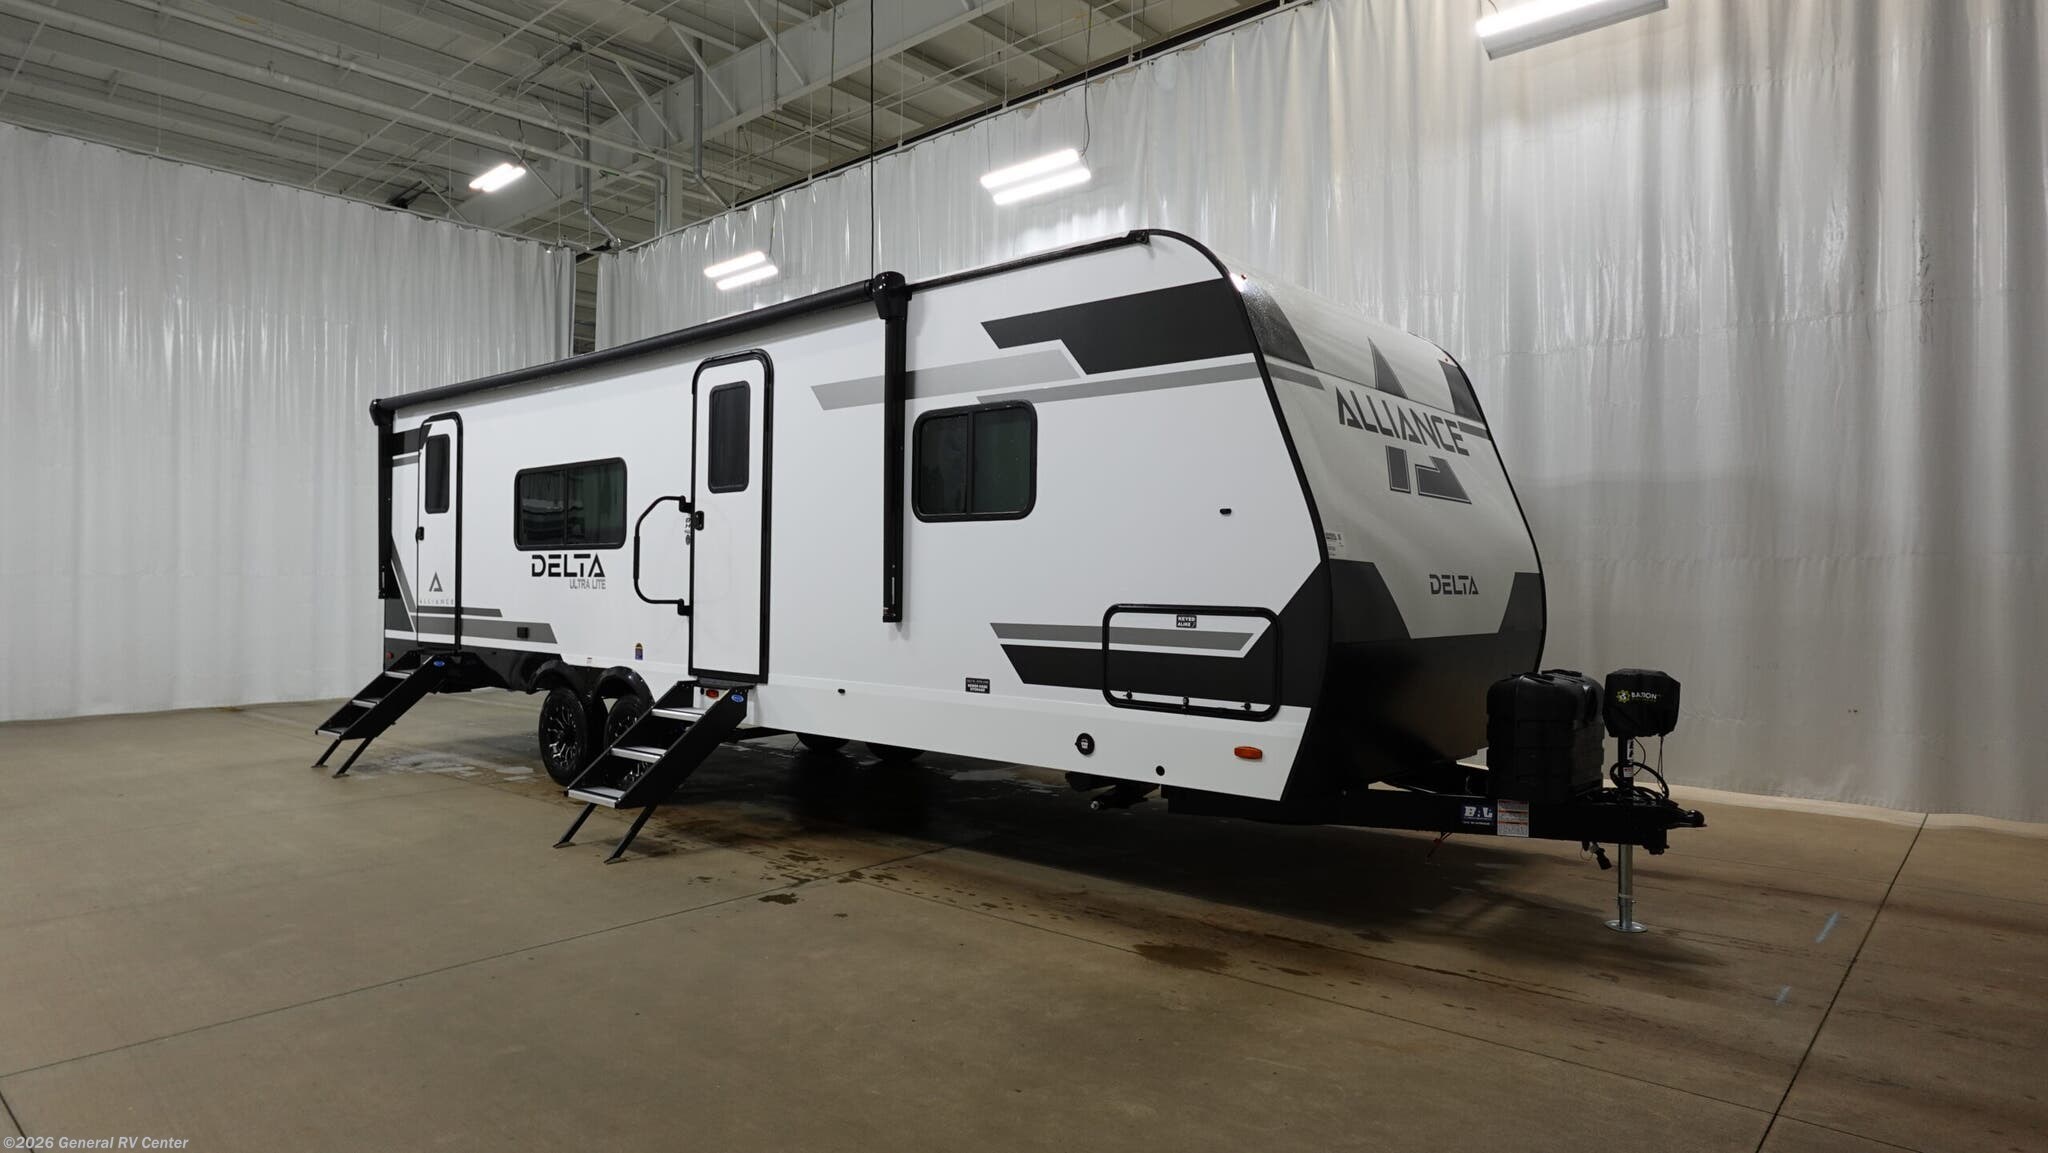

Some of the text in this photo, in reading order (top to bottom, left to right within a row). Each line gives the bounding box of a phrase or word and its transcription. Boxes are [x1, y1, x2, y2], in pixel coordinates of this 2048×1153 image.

[1336, 386, 1470, 456] ALLIANCE
[532, 552, 606, 578] DELTA
[569, 579, 607, 590] ULTRA LITE
[1429, 574, 1480, 596] DELTA
